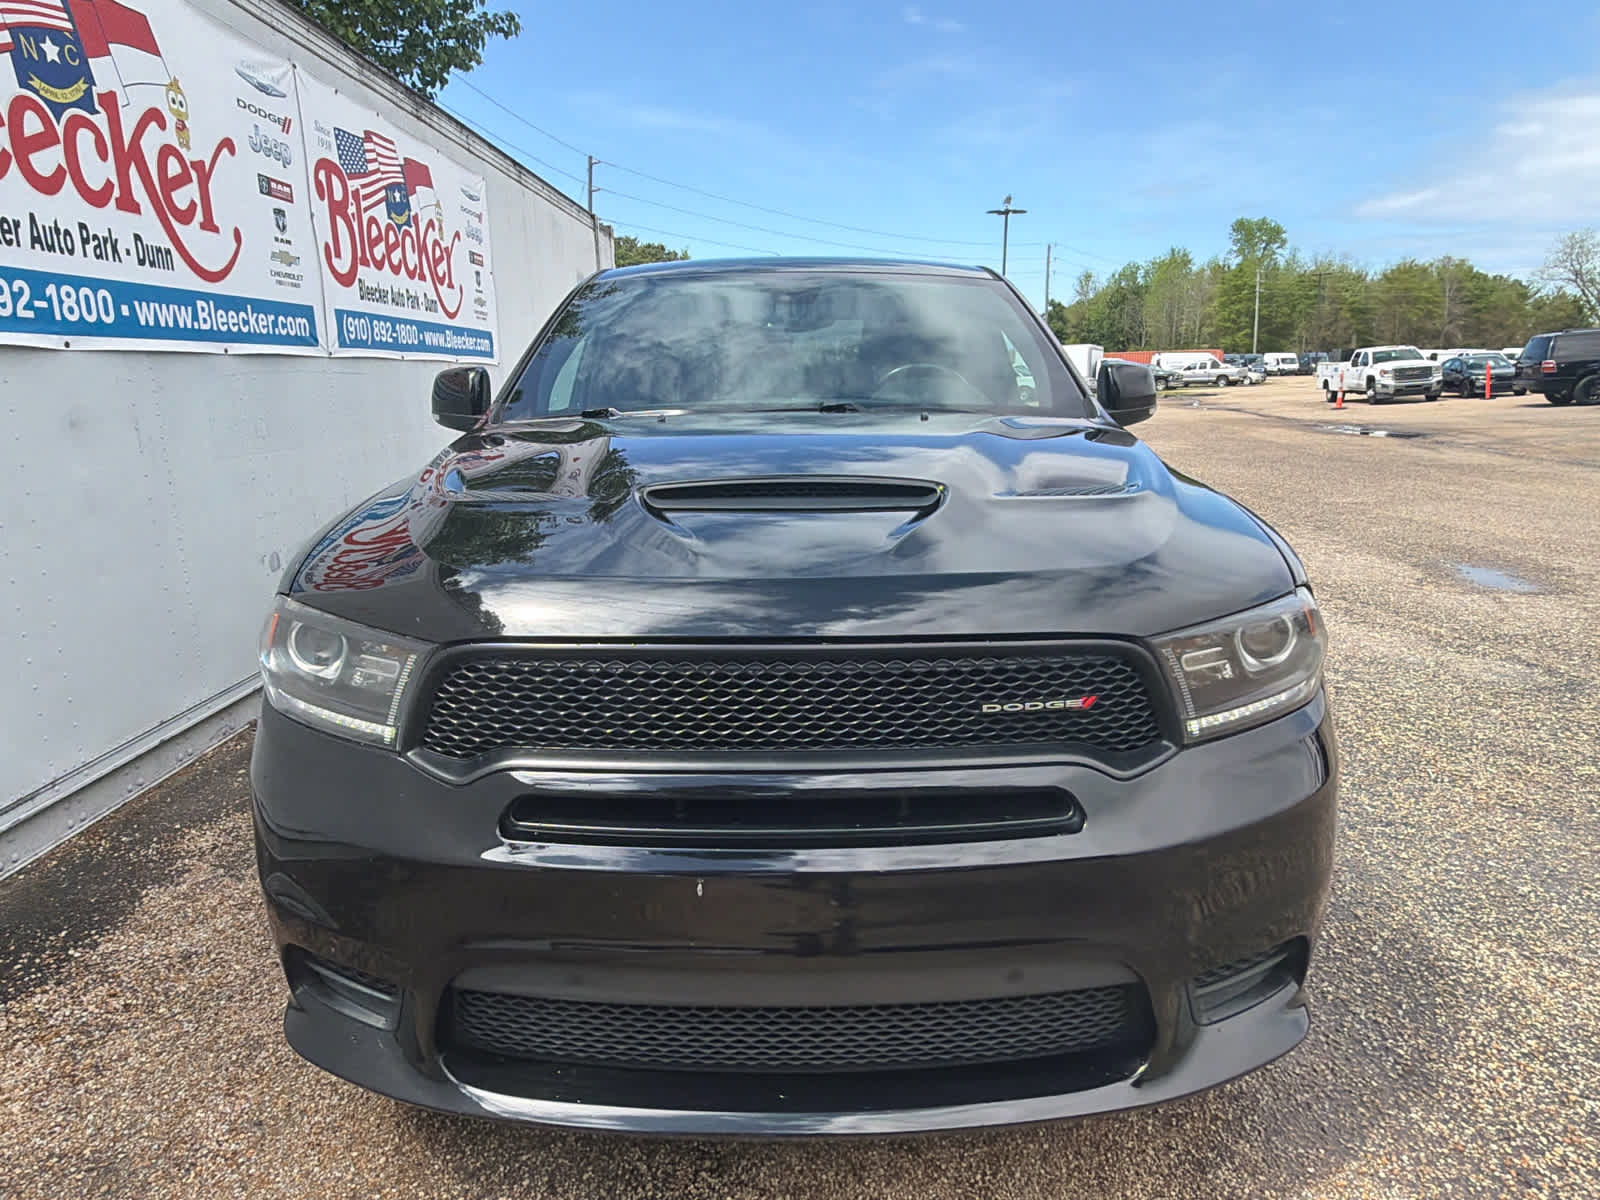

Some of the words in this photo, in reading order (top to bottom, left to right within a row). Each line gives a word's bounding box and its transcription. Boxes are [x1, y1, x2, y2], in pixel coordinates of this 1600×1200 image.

[19, 32, 39, 61] N
[64, 44, 80, 66] C
[236, 97, 286, 128] DODGE
[248, 123, 292, 168] Jeep
[29, 212, 75, 256] Auto
[78, 221, 123, 263] Park
[133, 232, 175, 271] Dunn
[358, 278, 389, 304] Bleecker
[391, 285, 406, 308] Auto
[406, 288, 420, 311] Park
[134, 299, 310, 337] www.Bleecker.com
[343, 313, 372, 345] (910)
[373, 320, 418, 345] 892-1800
[424, 330, 491, 353] www.Bleecker.com
[982, 699, 1084, 713] DODGE
